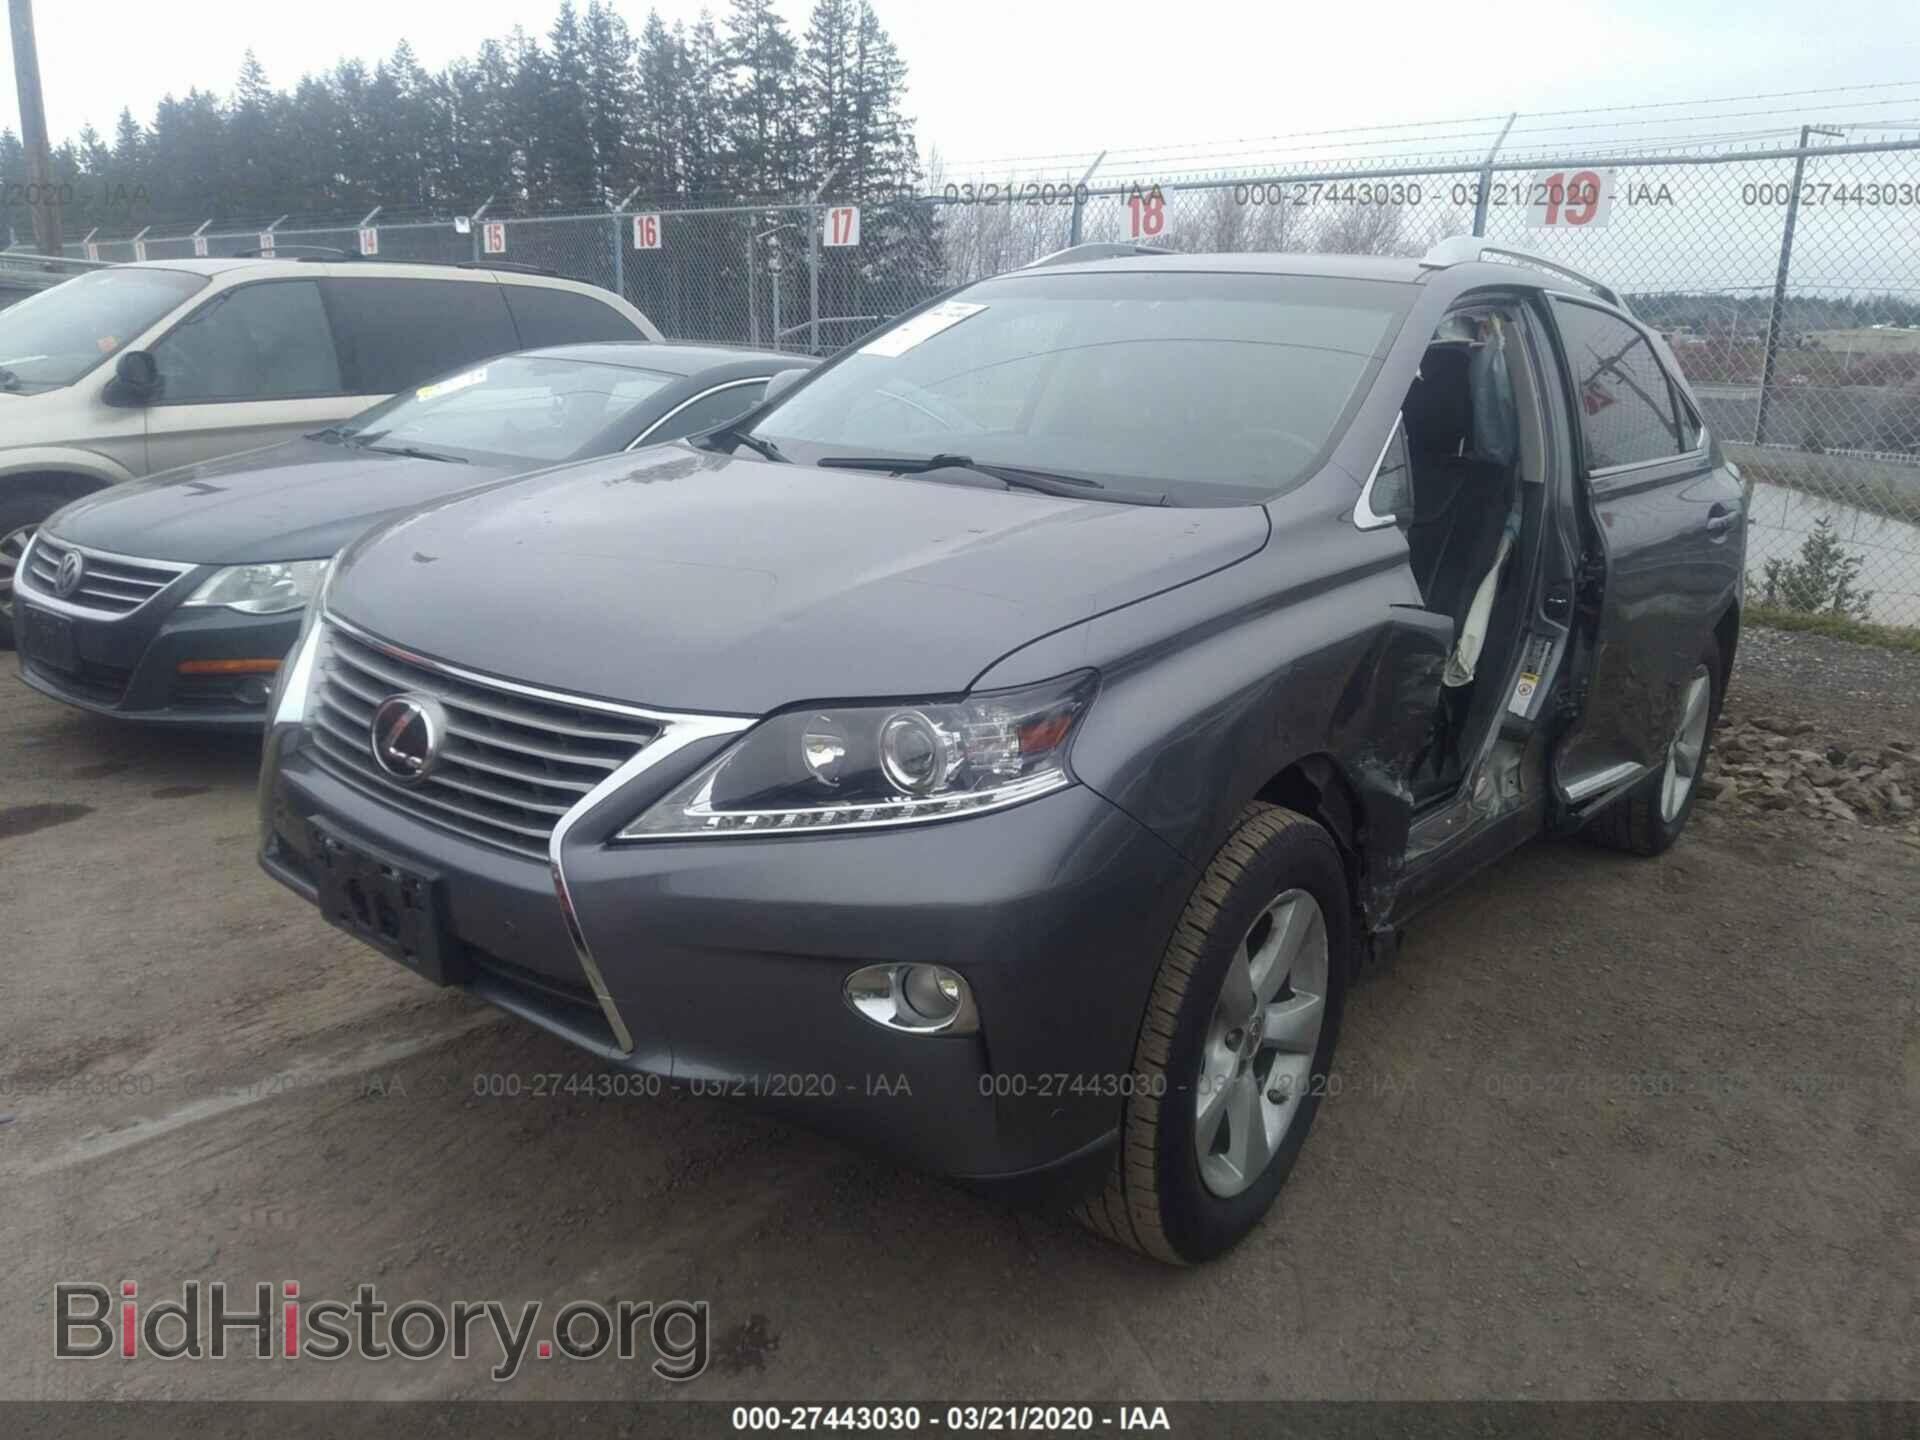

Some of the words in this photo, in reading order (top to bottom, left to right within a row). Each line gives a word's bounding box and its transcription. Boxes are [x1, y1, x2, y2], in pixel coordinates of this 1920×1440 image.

[1130, 191, 1165, 238] 18
[1545, 170, 1601, 226] 19
[488, 223, 504, 251] 15
[638, 217, 658, 248] 16
[831, 207, 853, 244] 17
